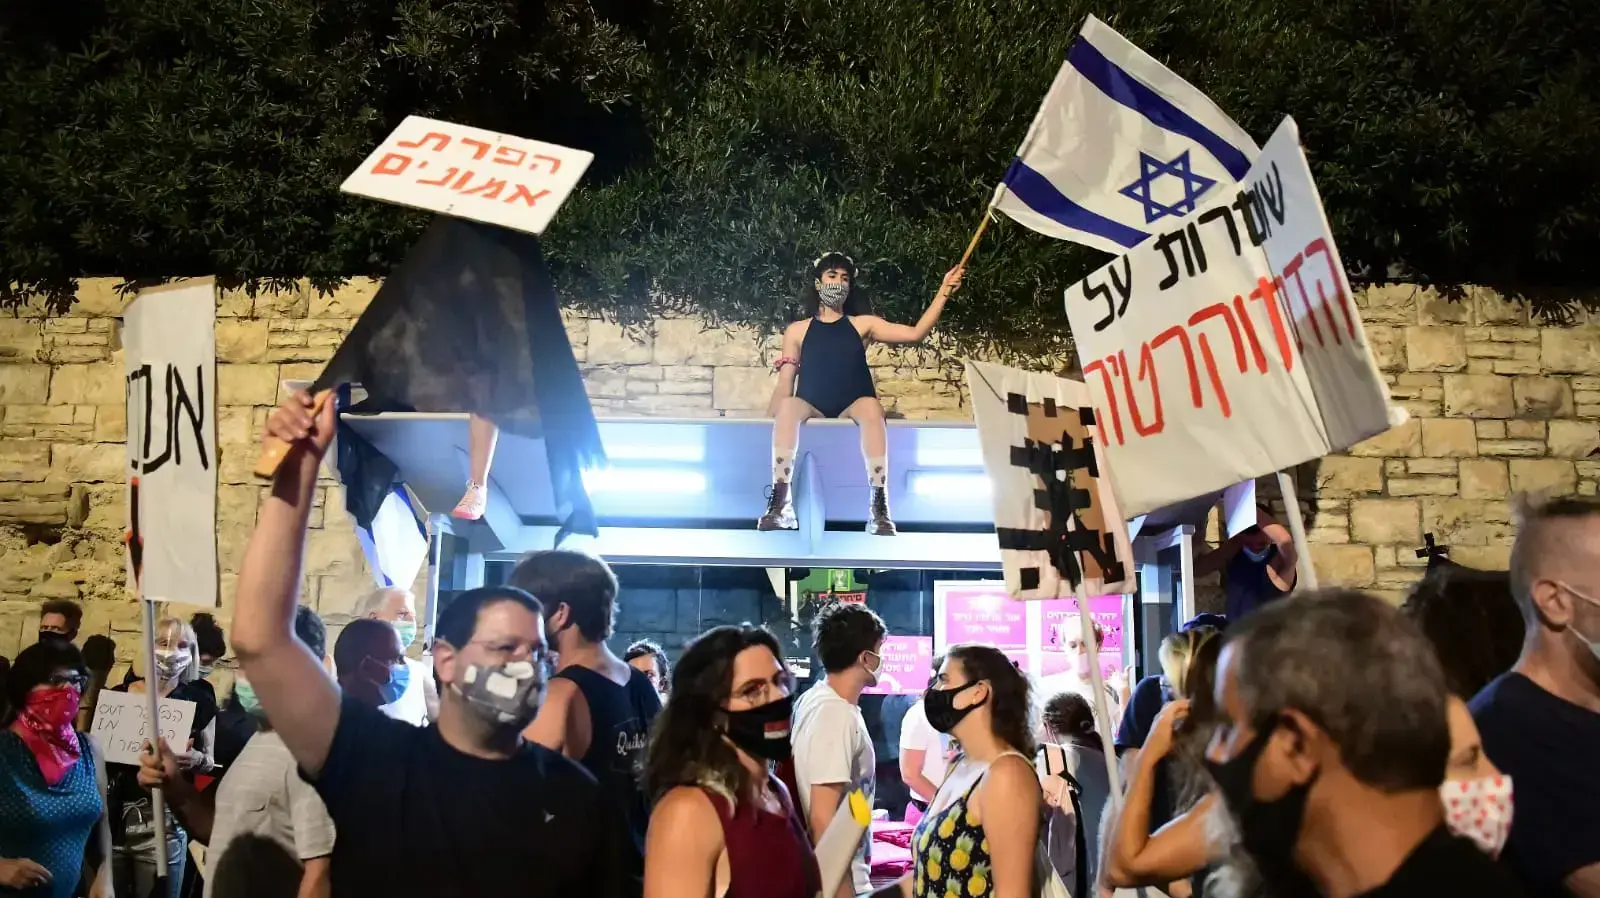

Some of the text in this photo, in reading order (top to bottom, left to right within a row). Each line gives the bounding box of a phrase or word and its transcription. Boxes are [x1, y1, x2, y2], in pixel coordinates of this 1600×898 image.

[396, 131, 562, 175] הפרת
[370, 152, 552, 208] אמונים
[1082, 253, 1132, 333] על
[97, 717, 120, 731] IN
[98, 703, 125, 717] OUT
